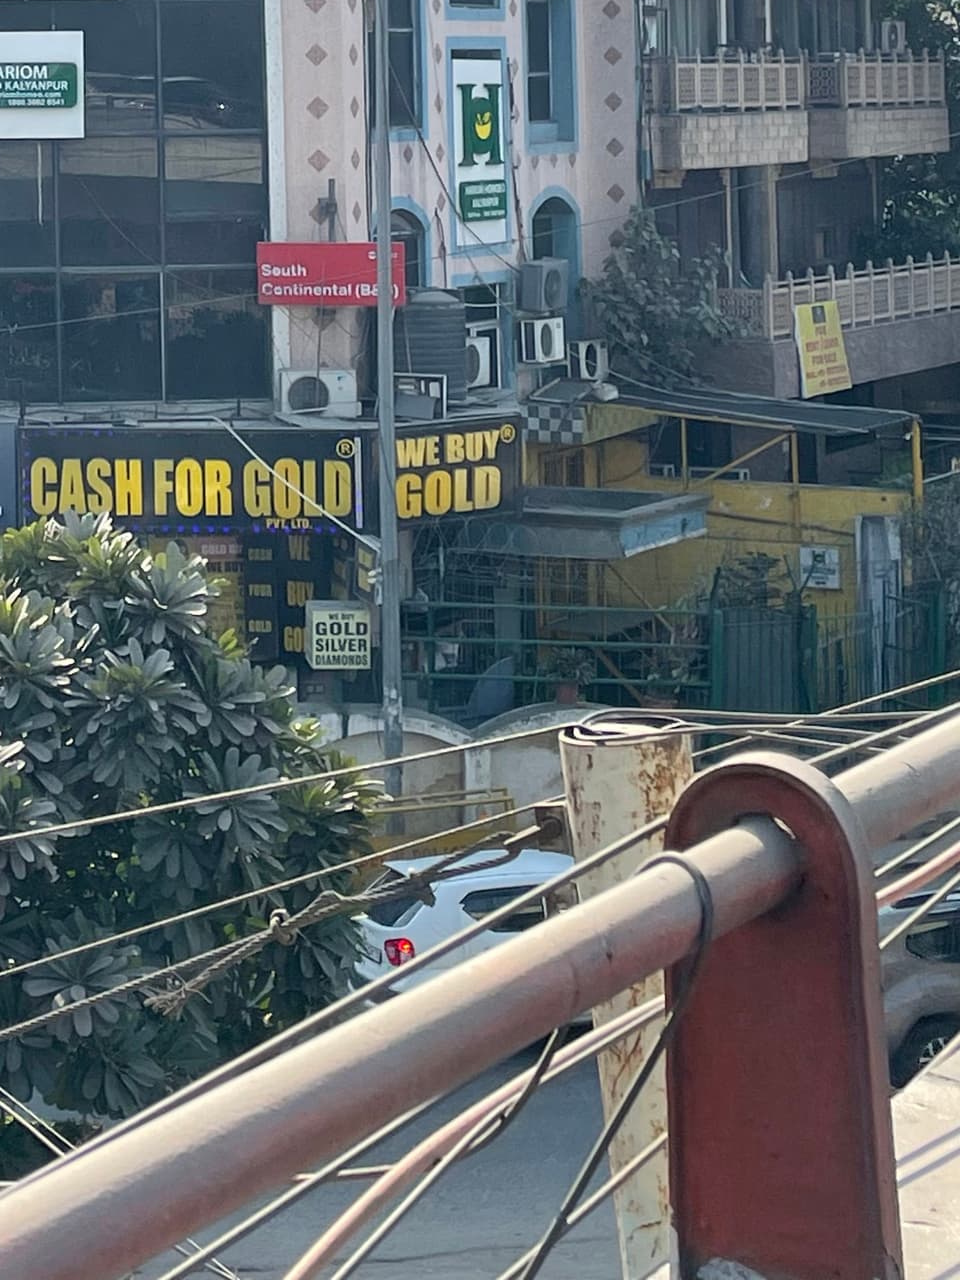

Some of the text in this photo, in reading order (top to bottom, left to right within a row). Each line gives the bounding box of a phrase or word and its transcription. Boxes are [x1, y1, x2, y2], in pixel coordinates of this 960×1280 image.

[4, 80, 69, 91] KALYANPUR
[261, 264, 307, 277] South
[262, 283, 353, 297] Continental
[395, 430, 500, 468] WE BUY
[30, 457, 352, 518] CASH FOR GOLD
[395, 465, 502, 519] GOLD
[291, 519, 313, 529] LTD.
[287, 580, 314, 606] BUY
[315, 622, 368, 636] GOLD
[315, 639, 368, 652] SILVER
[315, 654, 368, 666] DIAMONDS
